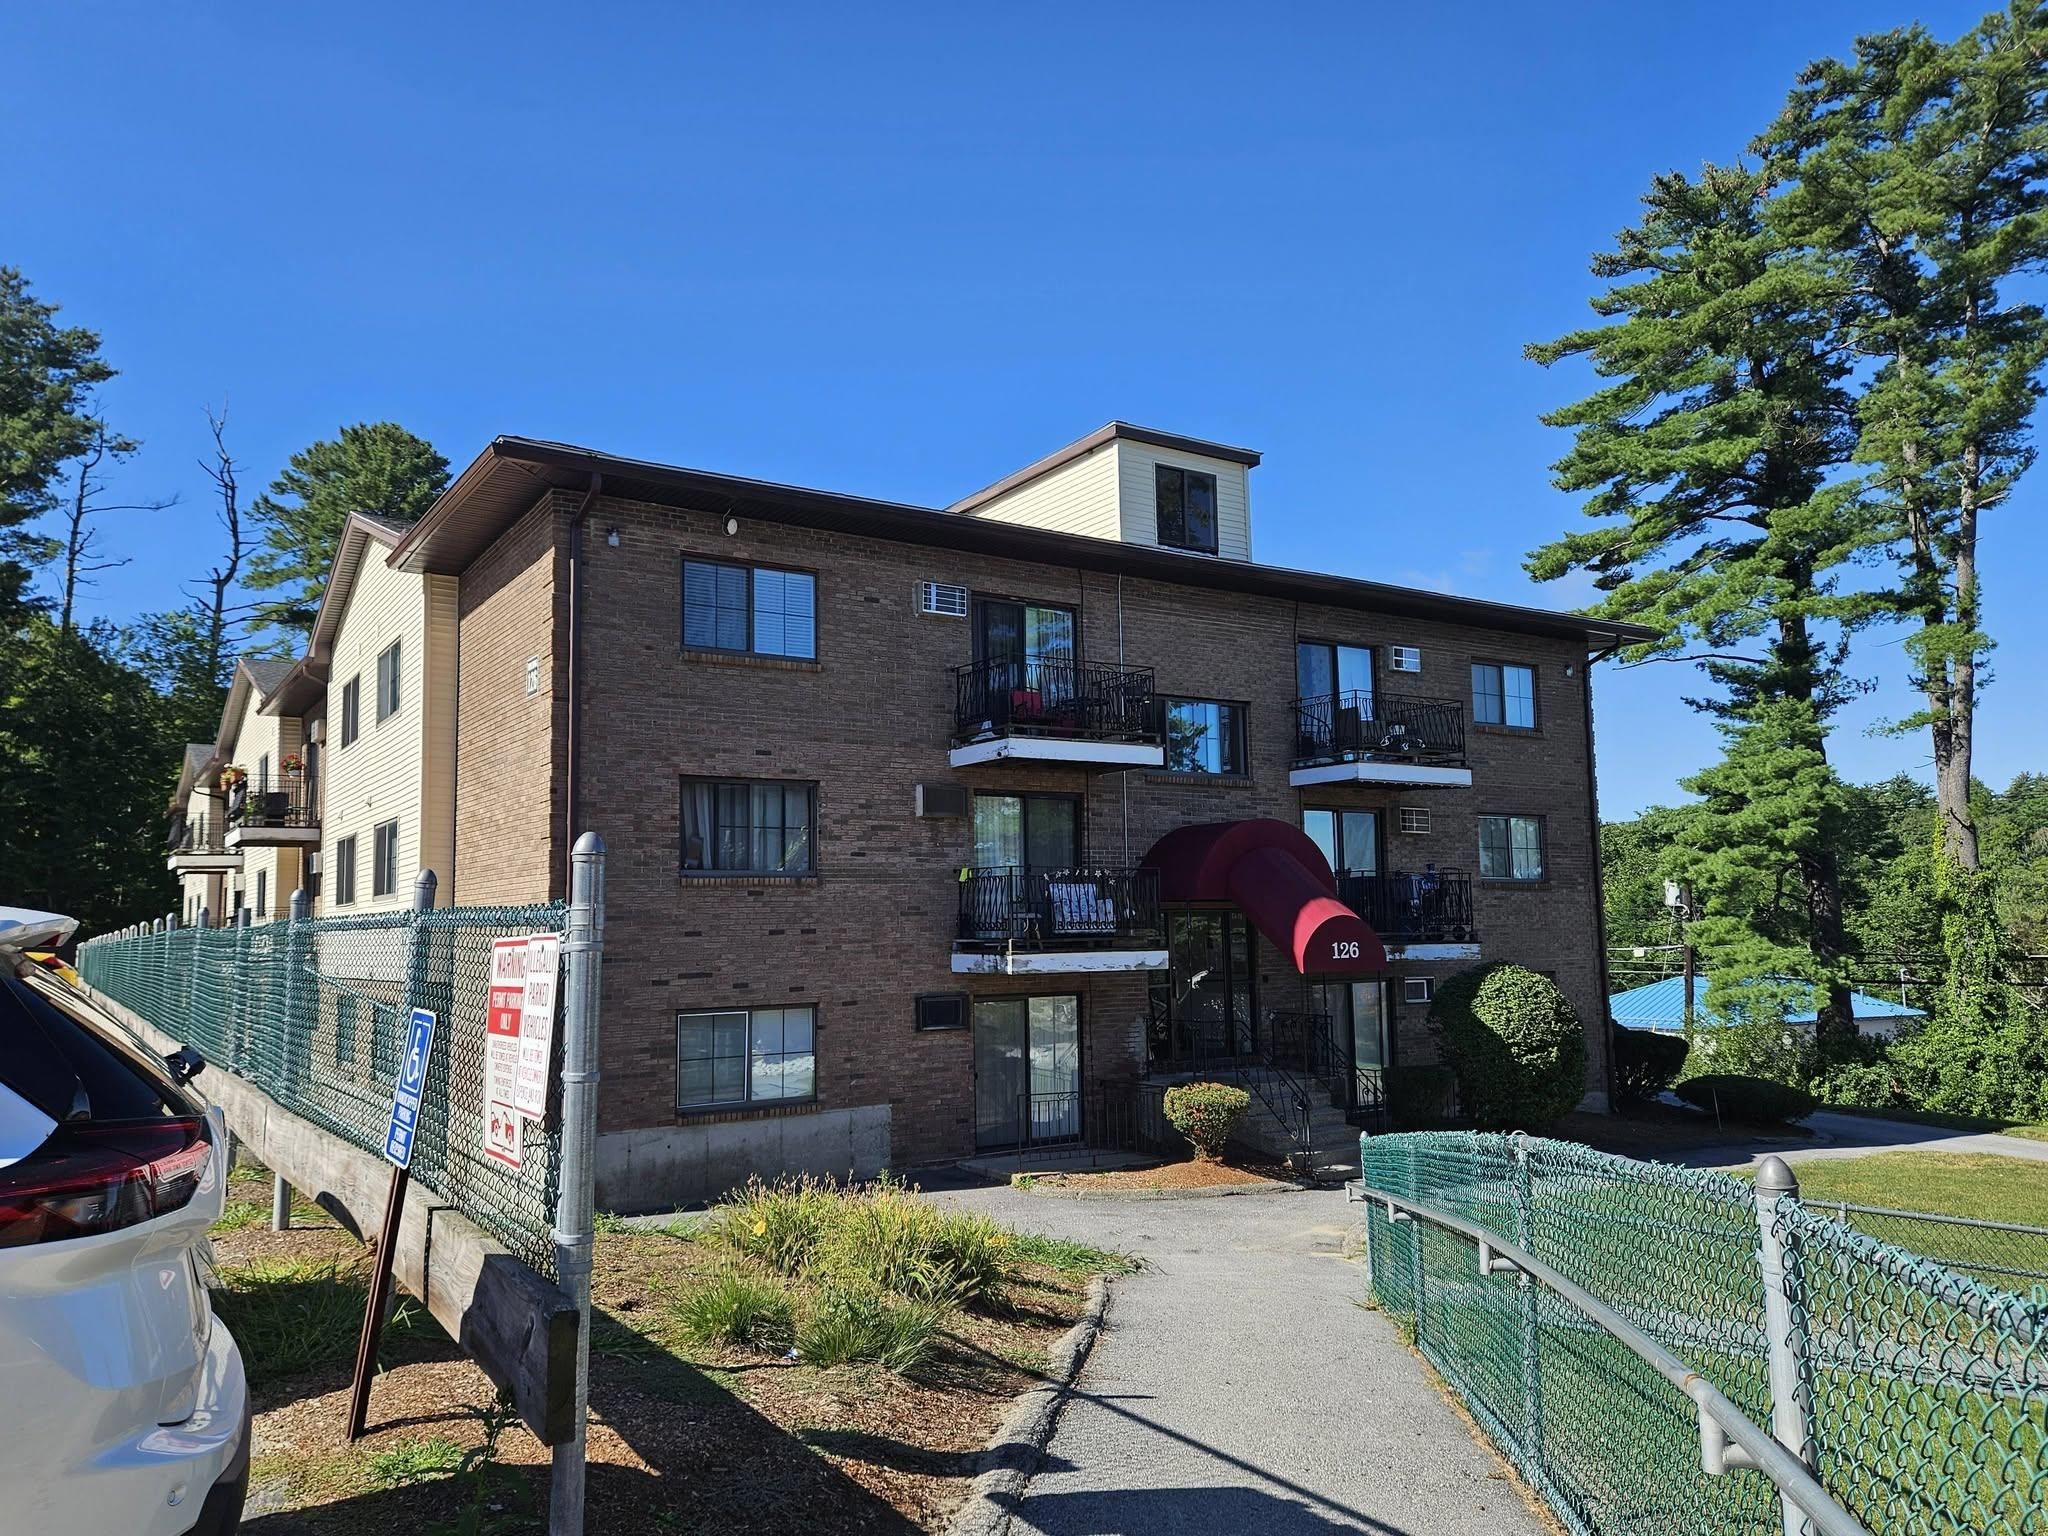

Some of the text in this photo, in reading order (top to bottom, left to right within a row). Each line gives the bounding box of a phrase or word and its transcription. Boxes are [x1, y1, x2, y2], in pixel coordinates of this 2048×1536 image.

[528, 950, 556, 973] ILLEGALLY
[1332, 942, 1360, 959] 126
[496, 952, 526, 978] WARNING
[528, 982, 550, 1007] PARKED
[500, 1013, 513, 1030] ONLY
[523, 1014, 549, 1041] VEHICLES
